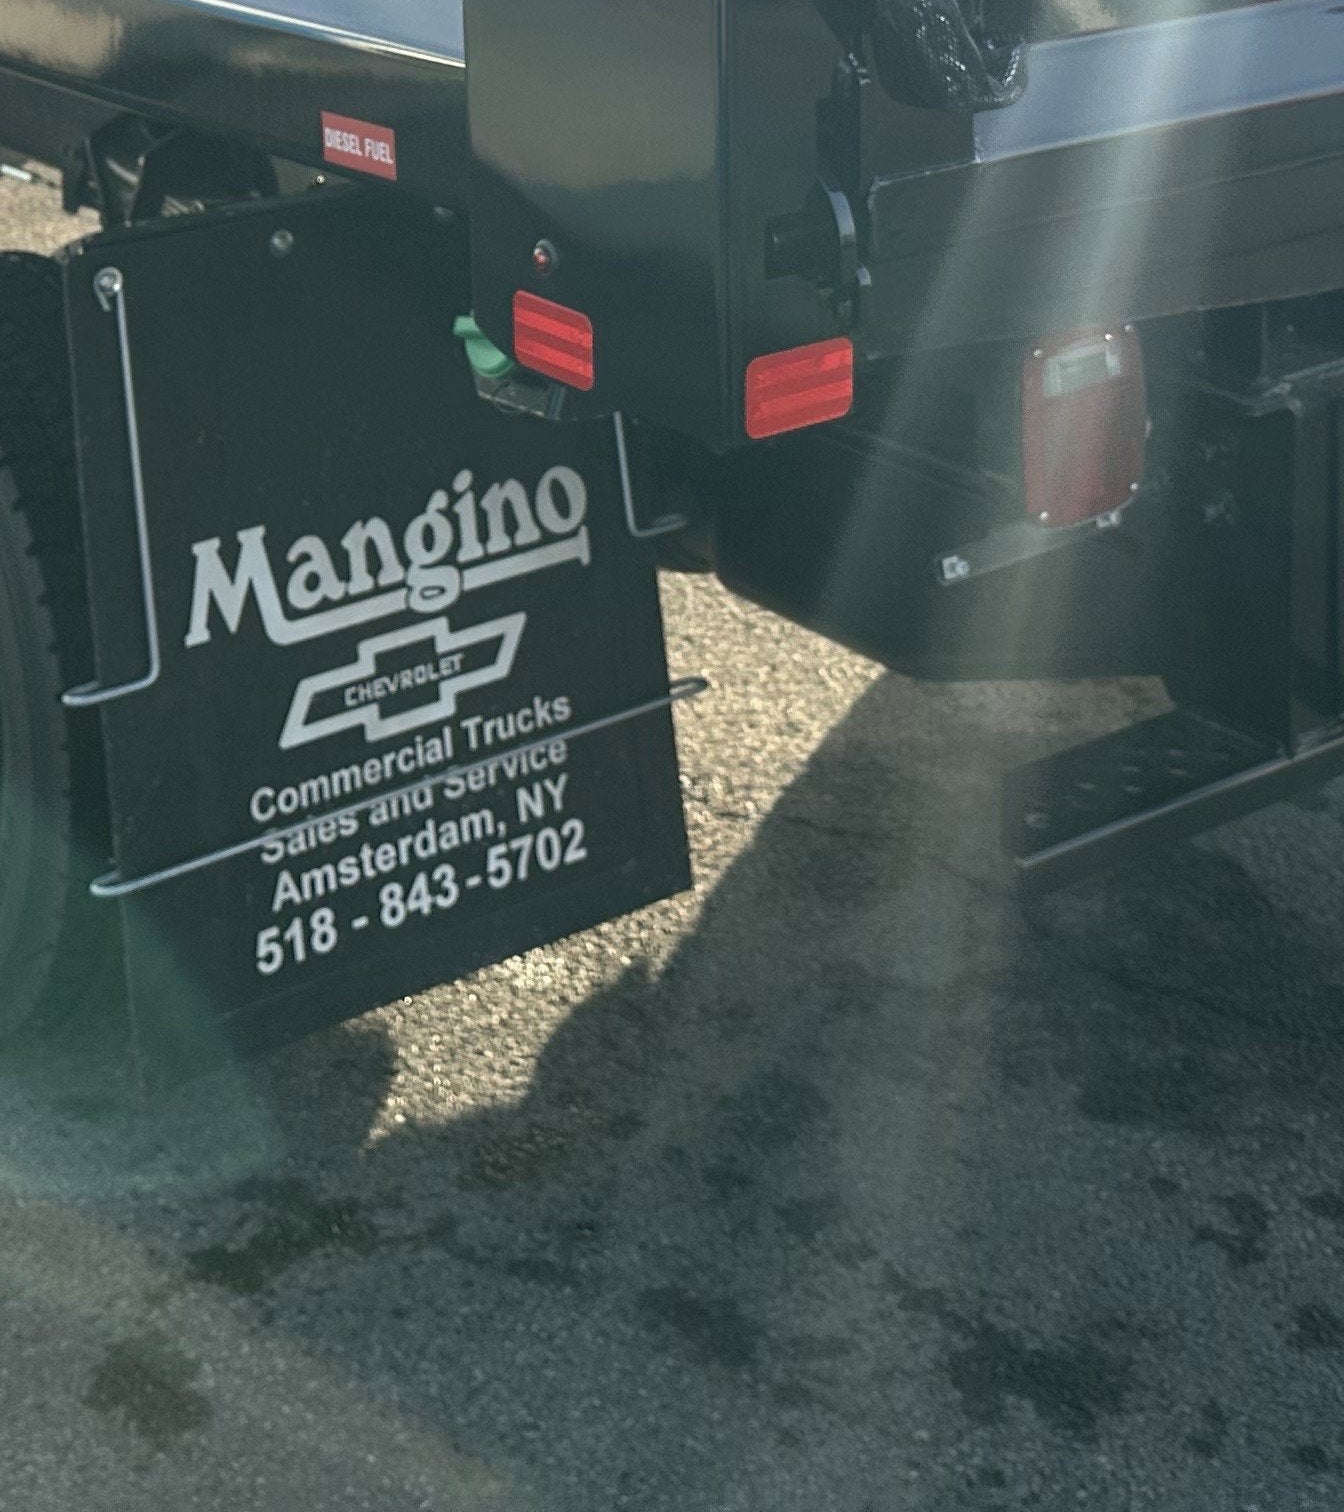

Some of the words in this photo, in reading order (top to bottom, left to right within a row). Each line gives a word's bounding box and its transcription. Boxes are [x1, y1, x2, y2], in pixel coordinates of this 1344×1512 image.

[324, 127, 363, 156] DIESEL
[364, 138, 394, 165] FUEL
[184, 465, 591, 648] Mangino
[344, 653, 465, 706] CHEVROLET
[250, 727, 454, 822] Commercial
[460, 695, 572, 751] Trucks
[260, 809, 359, 864] Sales
[369, 776, 434, 826] and
[443, 739, 568, 799] Service
[271, 808, 507, 912] Amsterdam,
[516, 772, 569, 824] NY
